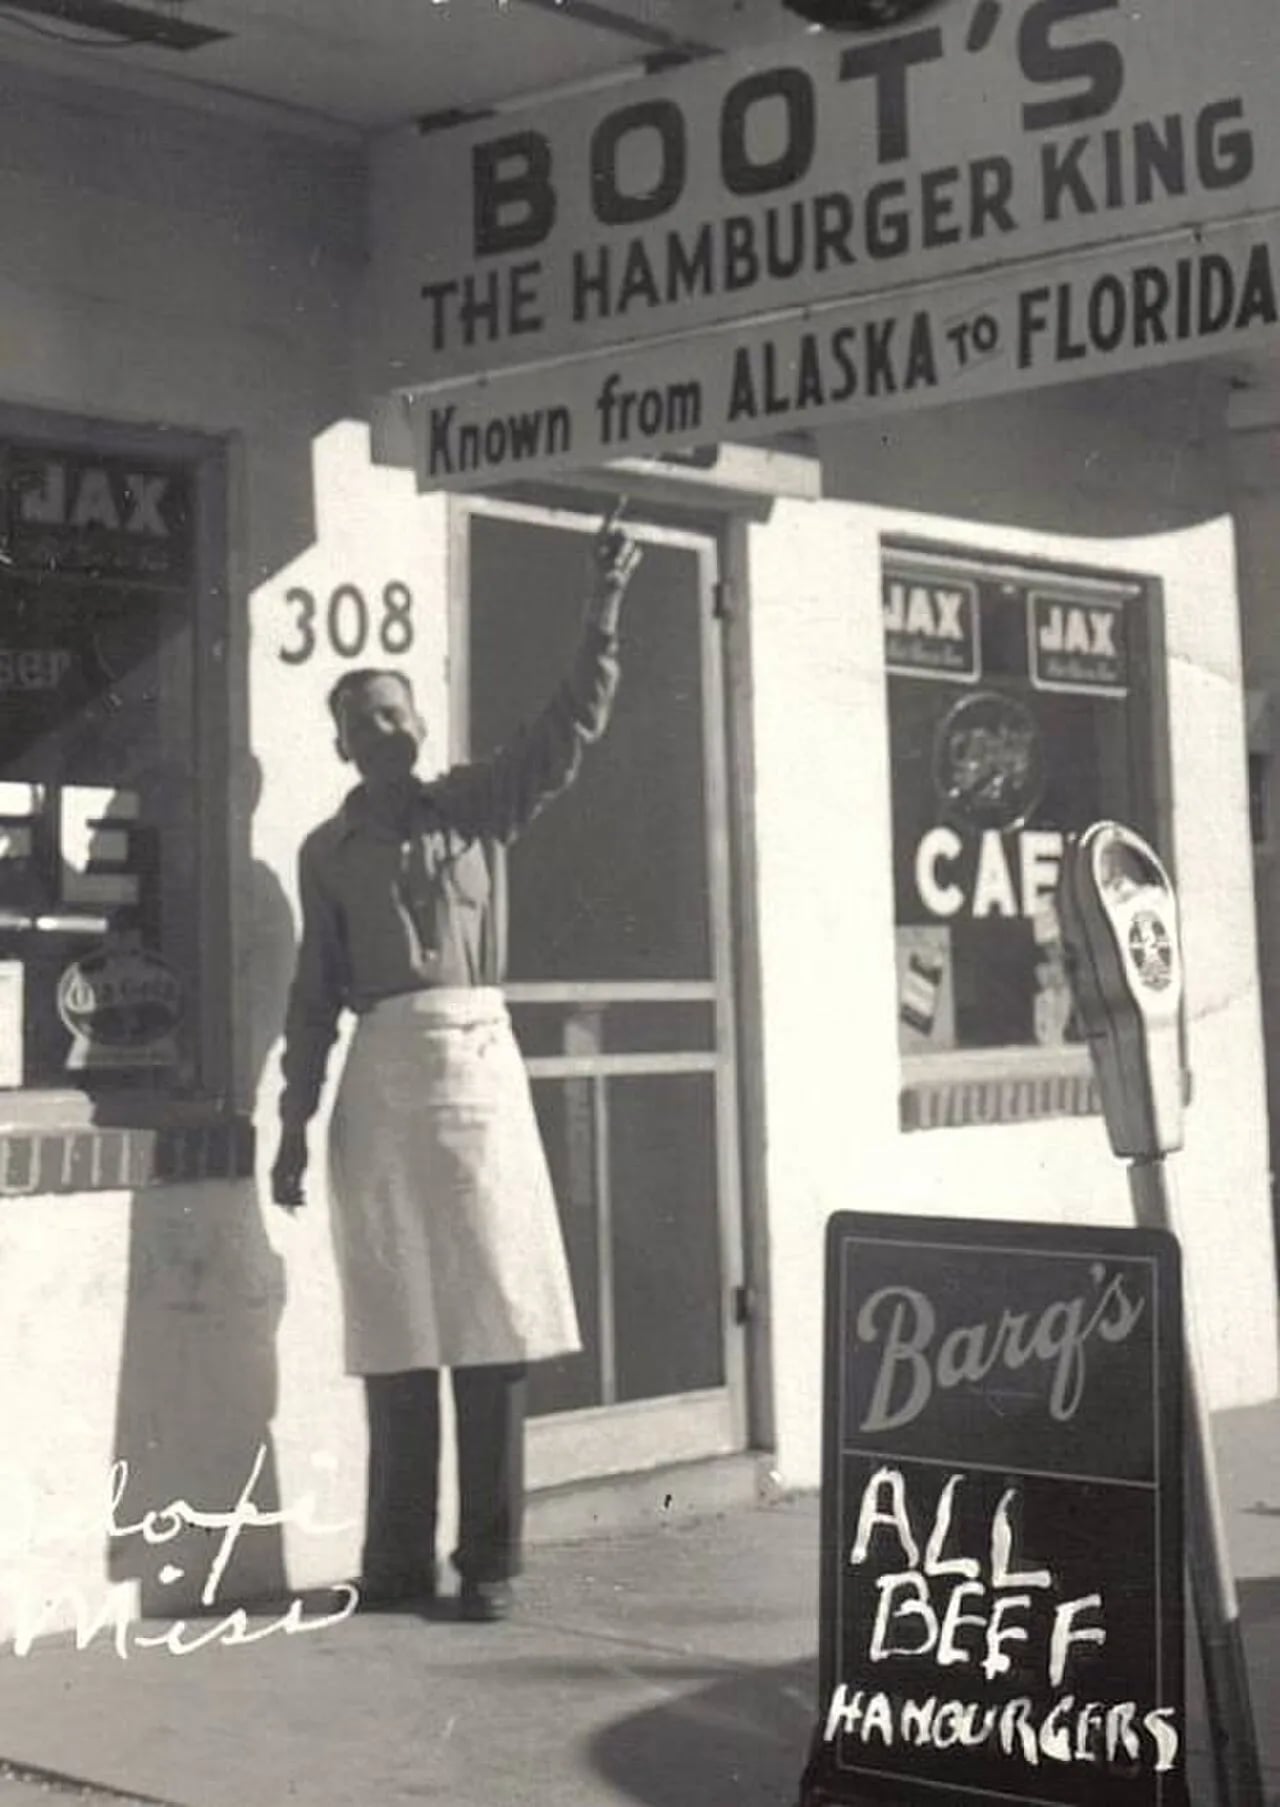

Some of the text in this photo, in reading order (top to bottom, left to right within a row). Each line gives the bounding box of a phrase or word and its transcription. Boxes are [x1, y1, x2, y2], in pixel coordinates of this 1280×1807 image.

[472, 0, 1126, 256] BOOT'S
[421, 96, 1254, 351] THE HAMBURGER KING
[427, 244, 1279, 476] Known from ALASKA TO FLORIDA
[20, 462, 170, 537] JAX
[279, 580, 414, 664] 308
[883, 585, 964, 641] JAX
[1040, 604, 1117, 659] JAX
[914, 826, 1076, 918] CAF
[856, 1263, 1146, 1432] Barq's
[851, 1465, 1052, 1588] ALL
[869, 1570, 1106, 1688] BEEF
